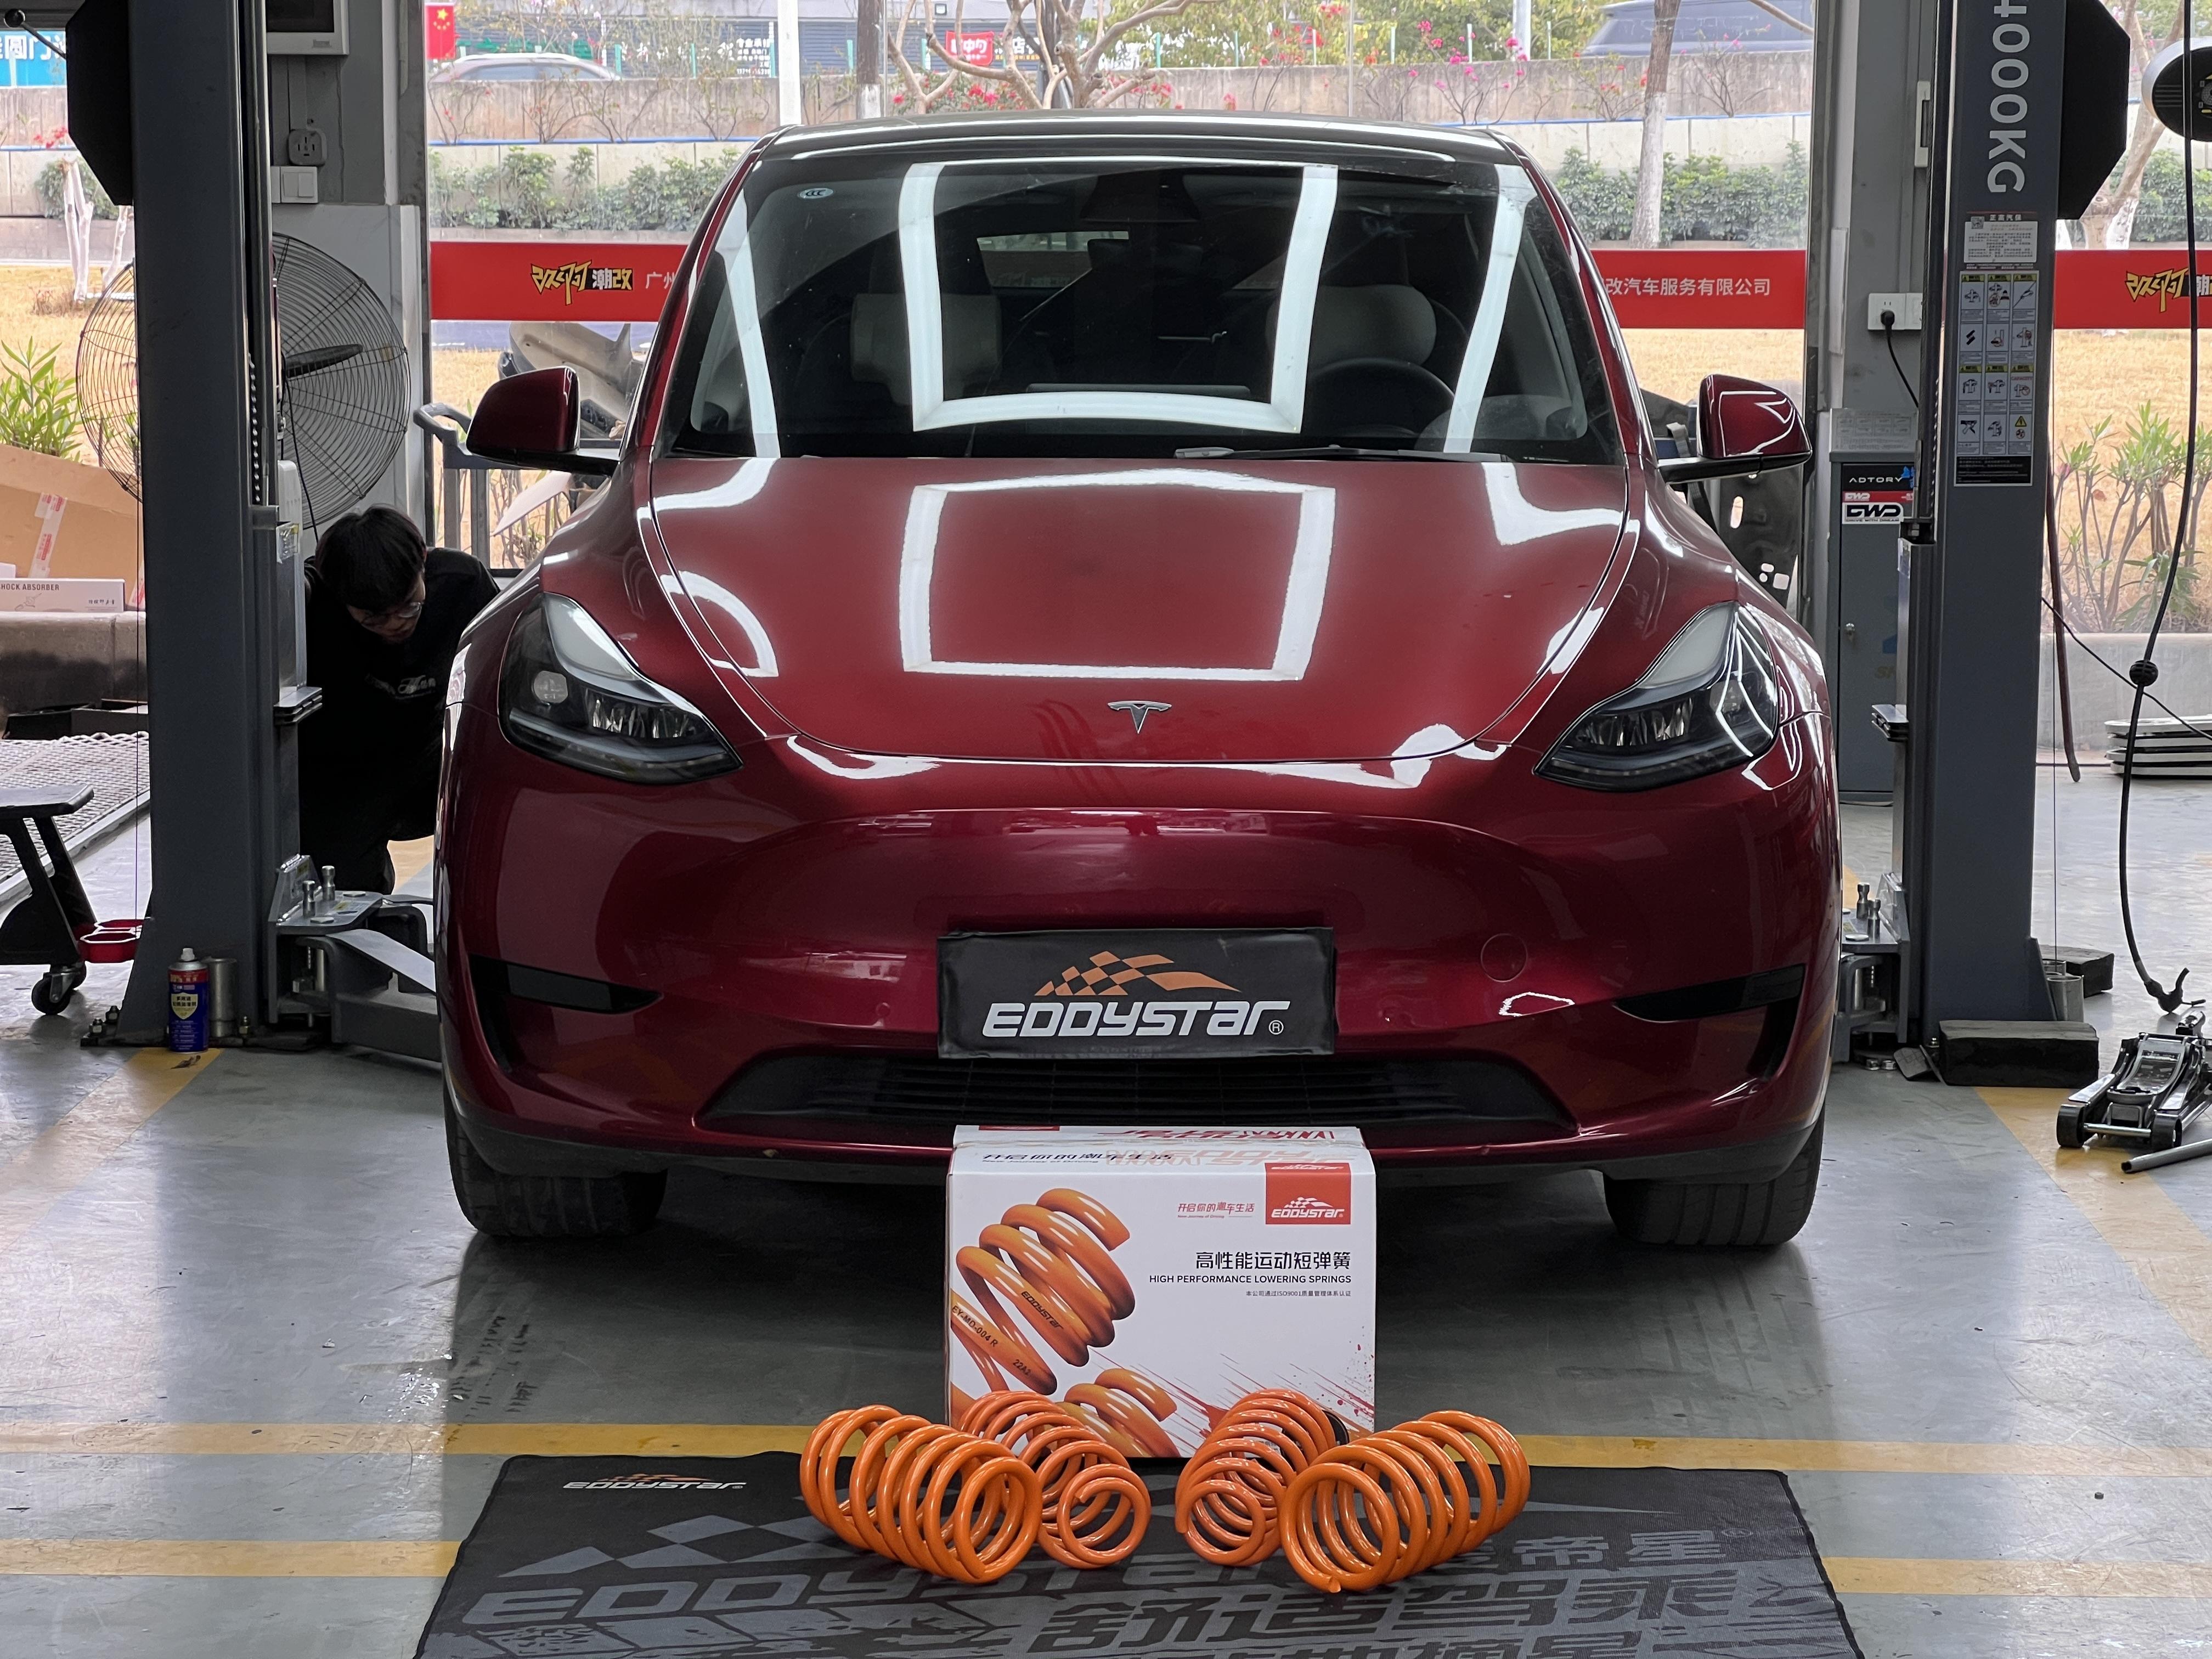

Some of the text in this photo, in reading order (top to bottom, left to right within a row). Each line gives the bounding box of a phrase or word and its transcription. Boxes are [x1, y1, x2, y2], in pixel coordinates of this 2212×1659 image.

[1987, 0, 2030, 193] 4000KG
[1177, 1201, 1255, 1215] 开启你的潮车生活
[1195, 1251, 1351, 1270] 高性能运动短弹簧
[1149, 1275, 1351, 1283] HIGH PERFORMANCE LOWERING SPRINGS
[951, 1305, 998, 1347] EY-MD-004 R
[1481, 1530, 1725, 1567] 帝星
